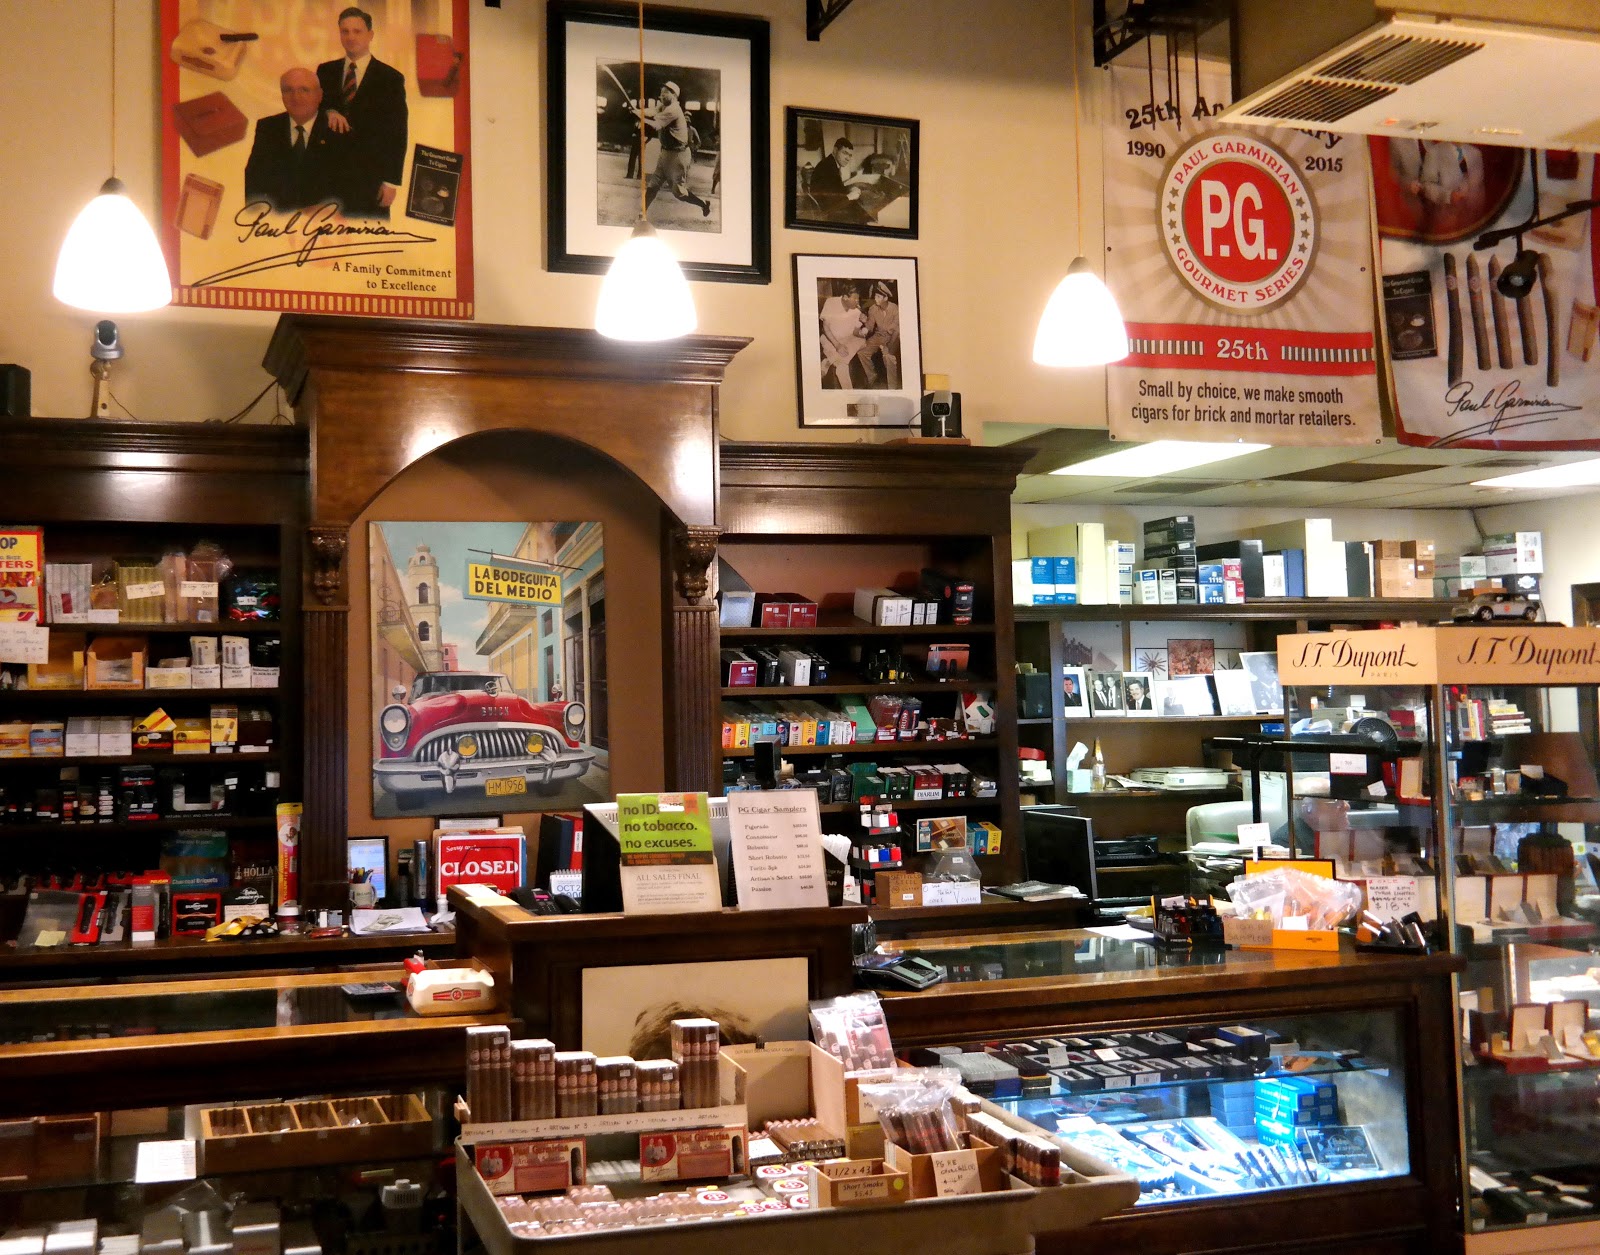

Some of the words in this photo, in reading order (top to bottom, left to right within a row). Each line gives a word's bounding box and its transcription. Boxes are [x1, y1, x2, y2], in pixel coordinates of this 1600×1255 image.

[1125, 102, 1182, 131] 25th
[1126, 140, 1166, 159] 1990
[1174, 148, 1209, 185] PAUL
[1212, 141, 1299, 196] GARMIRIAN
[1305, 156, 1343, 173] 2015
[235, 201, 298, 243] Paul
[1200, 179, 1278, 261] P.G.
[332, 262, 340, 272] A
[345, 262, 382, 276] Family
[385, 264, 452, 279] Commitment
[1176, 246, 1248, 303] GOURMET
[1255, 256, 1304, 302] SERIES
[366, 279, 378, 290] to
[381, 279, 437, 293] Excellence
[1216, 339, 1269, 361] 25th
[1138, 380, 1174, 398] Small
[1177, 381, 1193, 401] by
[1196, 381, 1241, 401] choice,
[1243, 388, 1261, 401] we
[1264, 386, 1295, 402] make
[1298, 387, 1344, 405] smooth
[1444, 382, 1493, 417] Paul
[1131, 404, 1169, 424] cigars
[1171, 404, 1191, 421] for
[1194, 404, 1227, 422] brick
[1230, 406, 1252, 424] and
[1255, 409, 1294, 426] mortar
[1299, 409, 1356, 427] retailers.
[474, 566, 490, 580] LA
[493, 569, 558, 588] BODEGUITA
[474, 580, 503, 596] DEL
[506, 584, 553, 600] MEDIO
[1331, 637, 1419, 678] Dupont
[1509, 634, 1600, 676] Dupont
[503, 780, 524, 794] 1956
[624, 807, 639, 816] no
[642, 803, 660, 815] ID.
[738, 806, 749, 814] PG
[751, 806, 771, 814] Cigar
[773, 805, 807, 813] Samplers
[624, 823, 641, 832] no
[642, 819, 698, 832] tobacco.
[625, 840, 642, 849] no
[644, 838, 697, 849] excuses.
[441, 860, 519, 877] CLOSED
[636, 873, 652, 882] ALL
[653, 873, 677, 881] SALES
[678, 872, 701, 881] FINAL
[556, 884, 574, 892] OCT
[826, 1169, 831, 1177] 3
